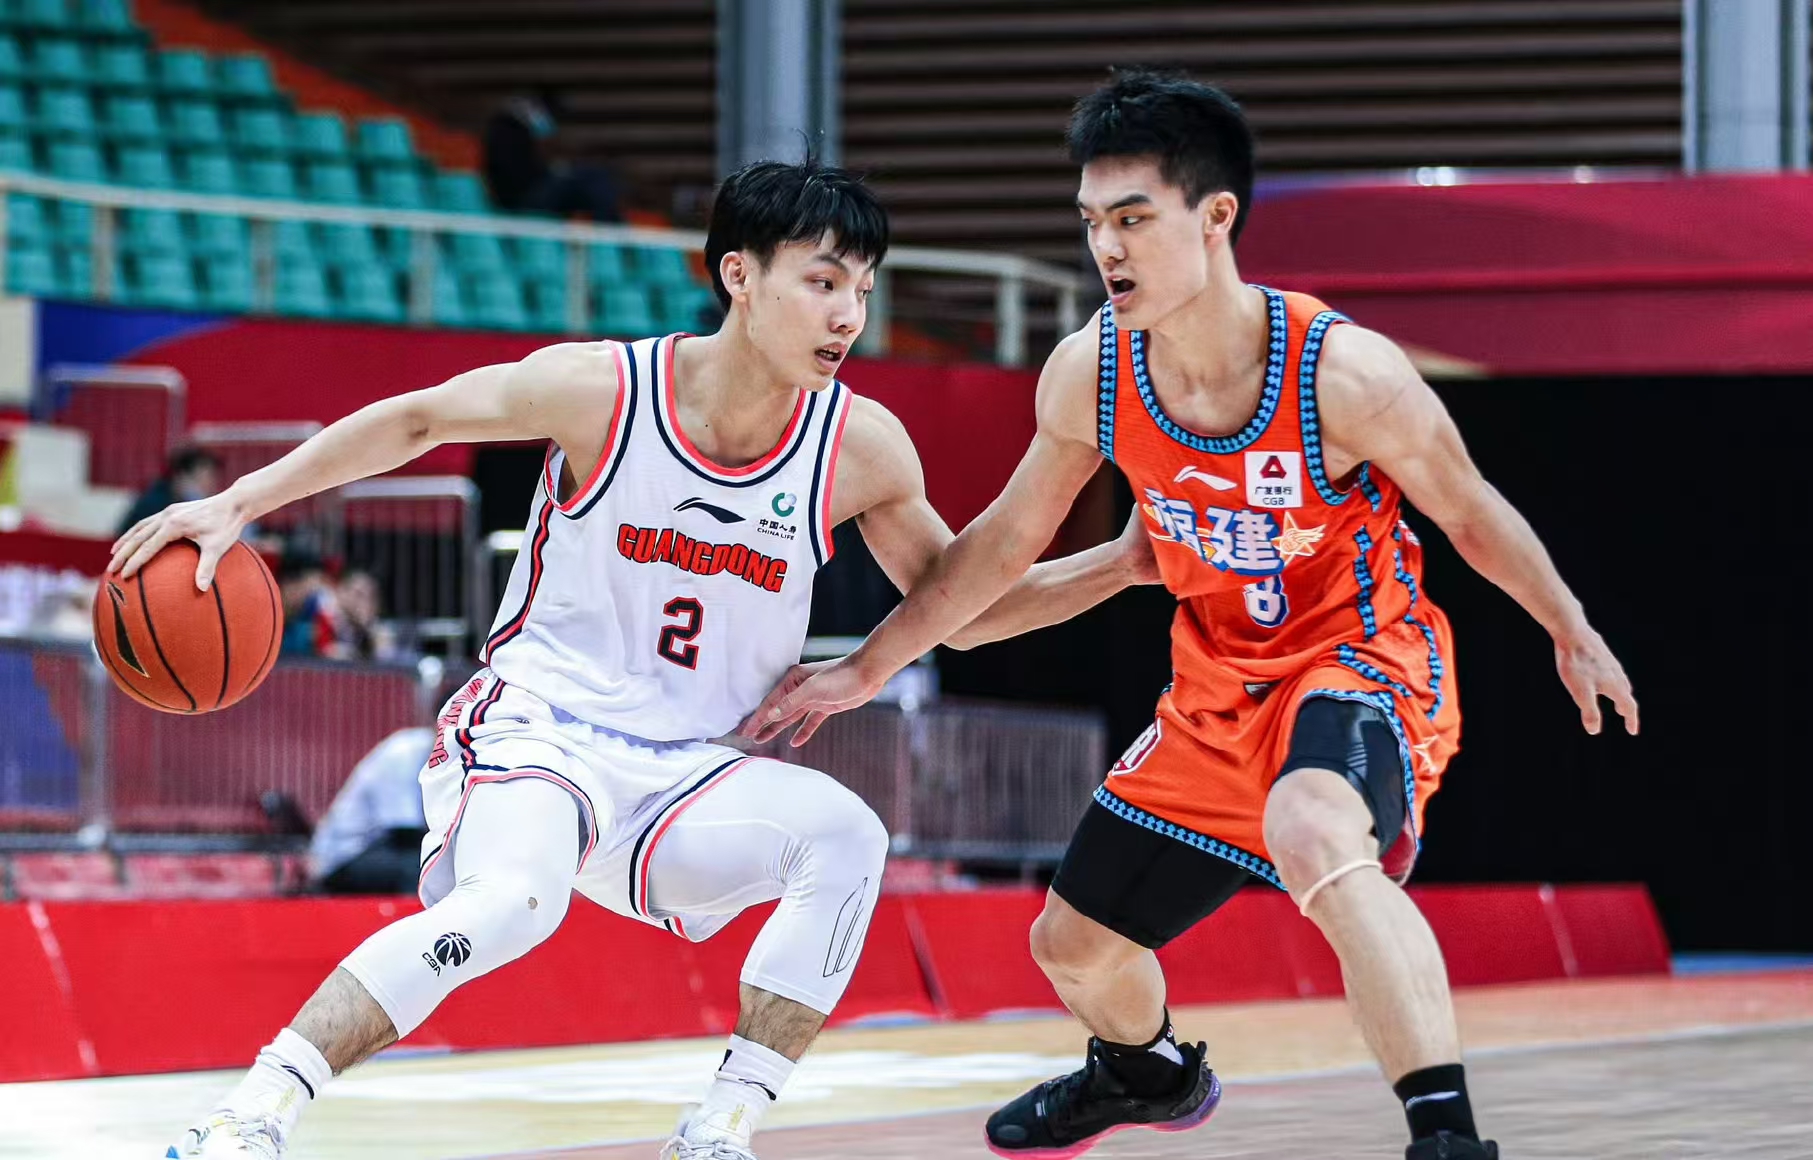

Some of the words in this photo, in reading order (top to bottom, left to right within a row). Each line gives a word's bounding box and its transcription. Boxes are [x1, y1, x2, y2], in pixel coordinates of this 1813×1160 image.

[1262, 497, 1285, 506] CGB
[757, 527, 780, 537] CHINA
[780, 532, 795, 541] LIFE
[759, 518, 797, 534] 中国人寿
[1143, 487, 1286, 576] 福建
[616, 523, 788, 593] GUANGDONG
[656, 596, 704, 671] 2
